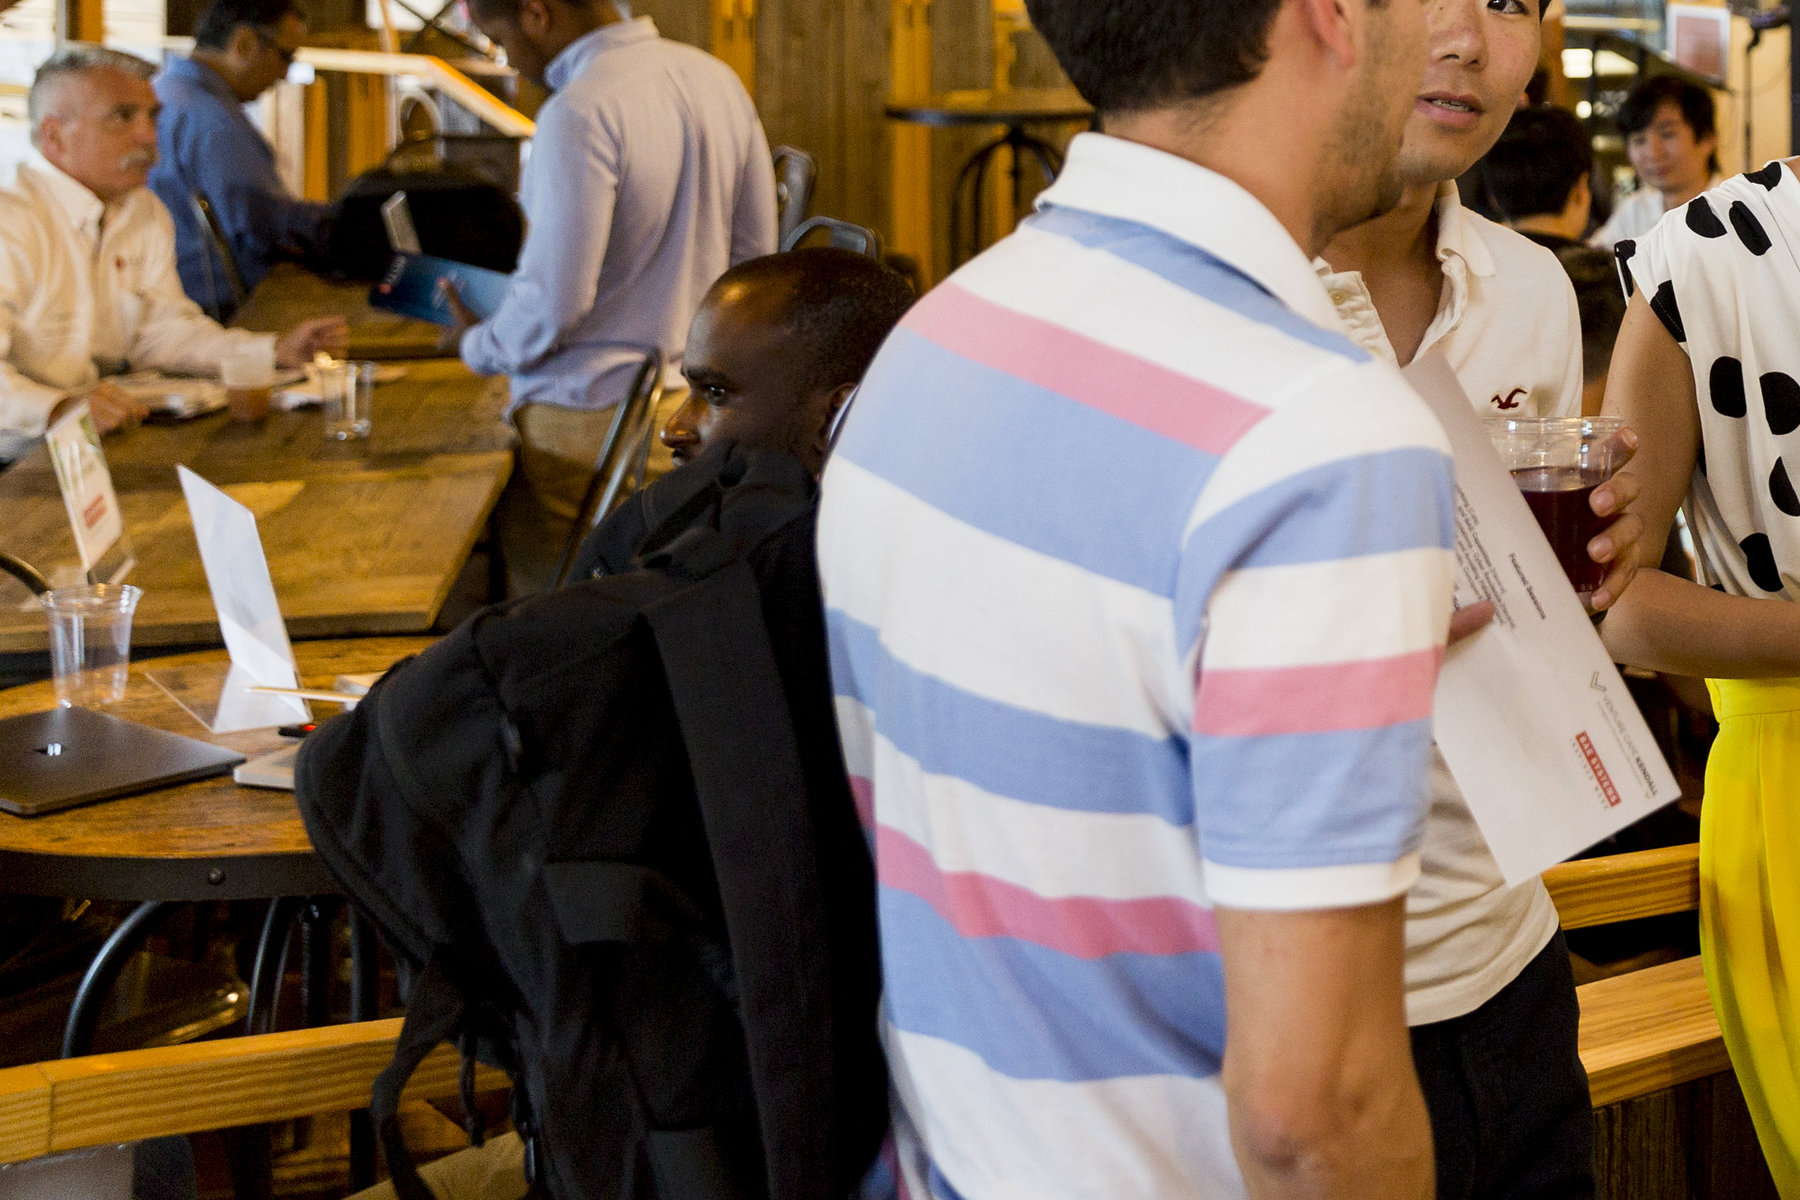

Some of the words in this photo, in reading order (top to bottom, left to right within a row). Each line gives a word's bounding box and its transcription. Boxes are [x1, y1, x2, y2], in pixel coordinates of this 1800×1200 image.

[1508, 552, 1529, 585] Featured
[1526, 585, 1548, 619] Sessions
[1577, 734, 1594, 757] BAE
[1588, 755, 1618, 803] SYSTEMS
